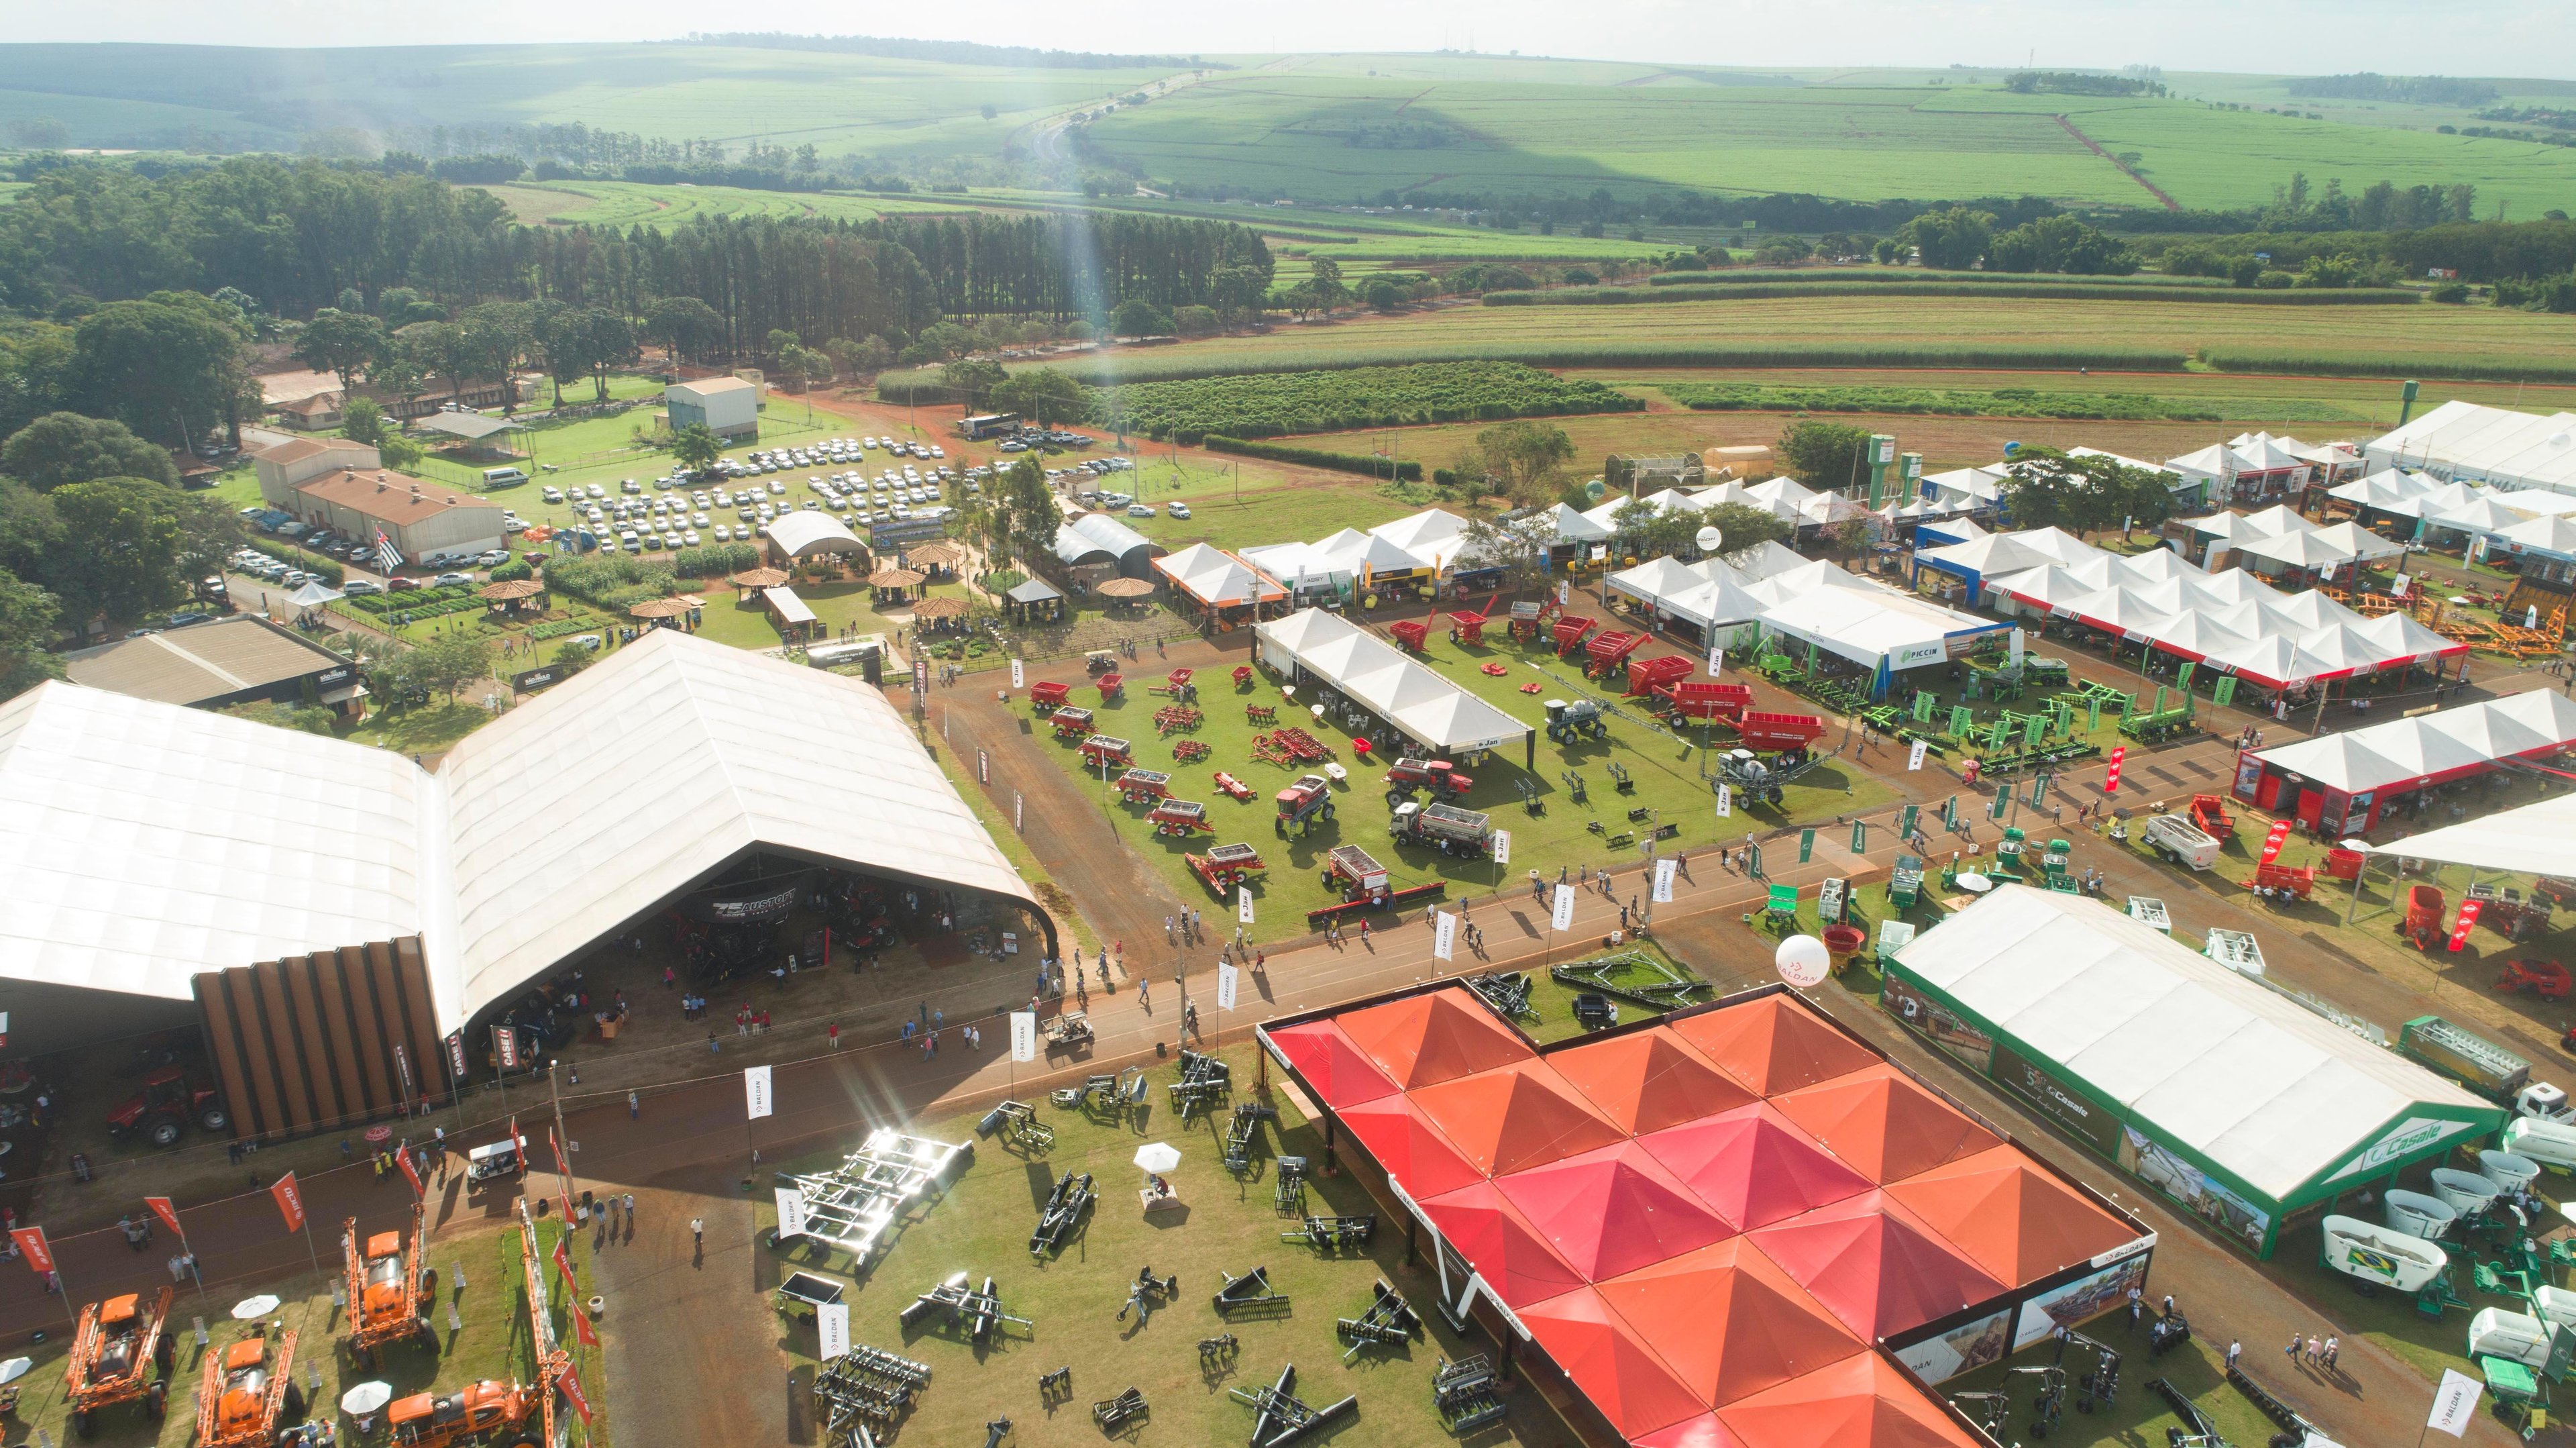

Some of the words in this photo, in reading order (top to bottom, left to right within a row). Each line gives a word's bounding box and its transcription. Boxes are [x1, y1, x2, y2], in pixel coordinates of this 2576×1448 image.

[1911, 648, 1937, 658] PICCIN
[2220, 678, 2230, 697] PICCIN
[1956, 709, 1964, 730] PICCIN
[1996, 723, 2005, 742] PICCIN
[2031, 717, 2040, 736] PICCIN
[2034, 780, 2044, 806] Casale
[1855, 824, 1863, 850] Casale
[712, 902, 743, 915] 75
[741, 888, 796, 913] AUSTOFT
[1777, 963, 1818, 982] BALDAN
[452, 1045, 464, 1076] CASE
[500, 1039, 513, 1067] CASE
[2055, 1091, 2088, 1118] Casale
[2385, 1125, 2442, 1156] Casale
[284, 1186, 301, 1213] jacto
[1402, 1195, 1425, 1223] BALDAN
[2114, 1242, 2145, 1259] BALDAN
[2445, 1390, 2463, 1418] BALDAN
